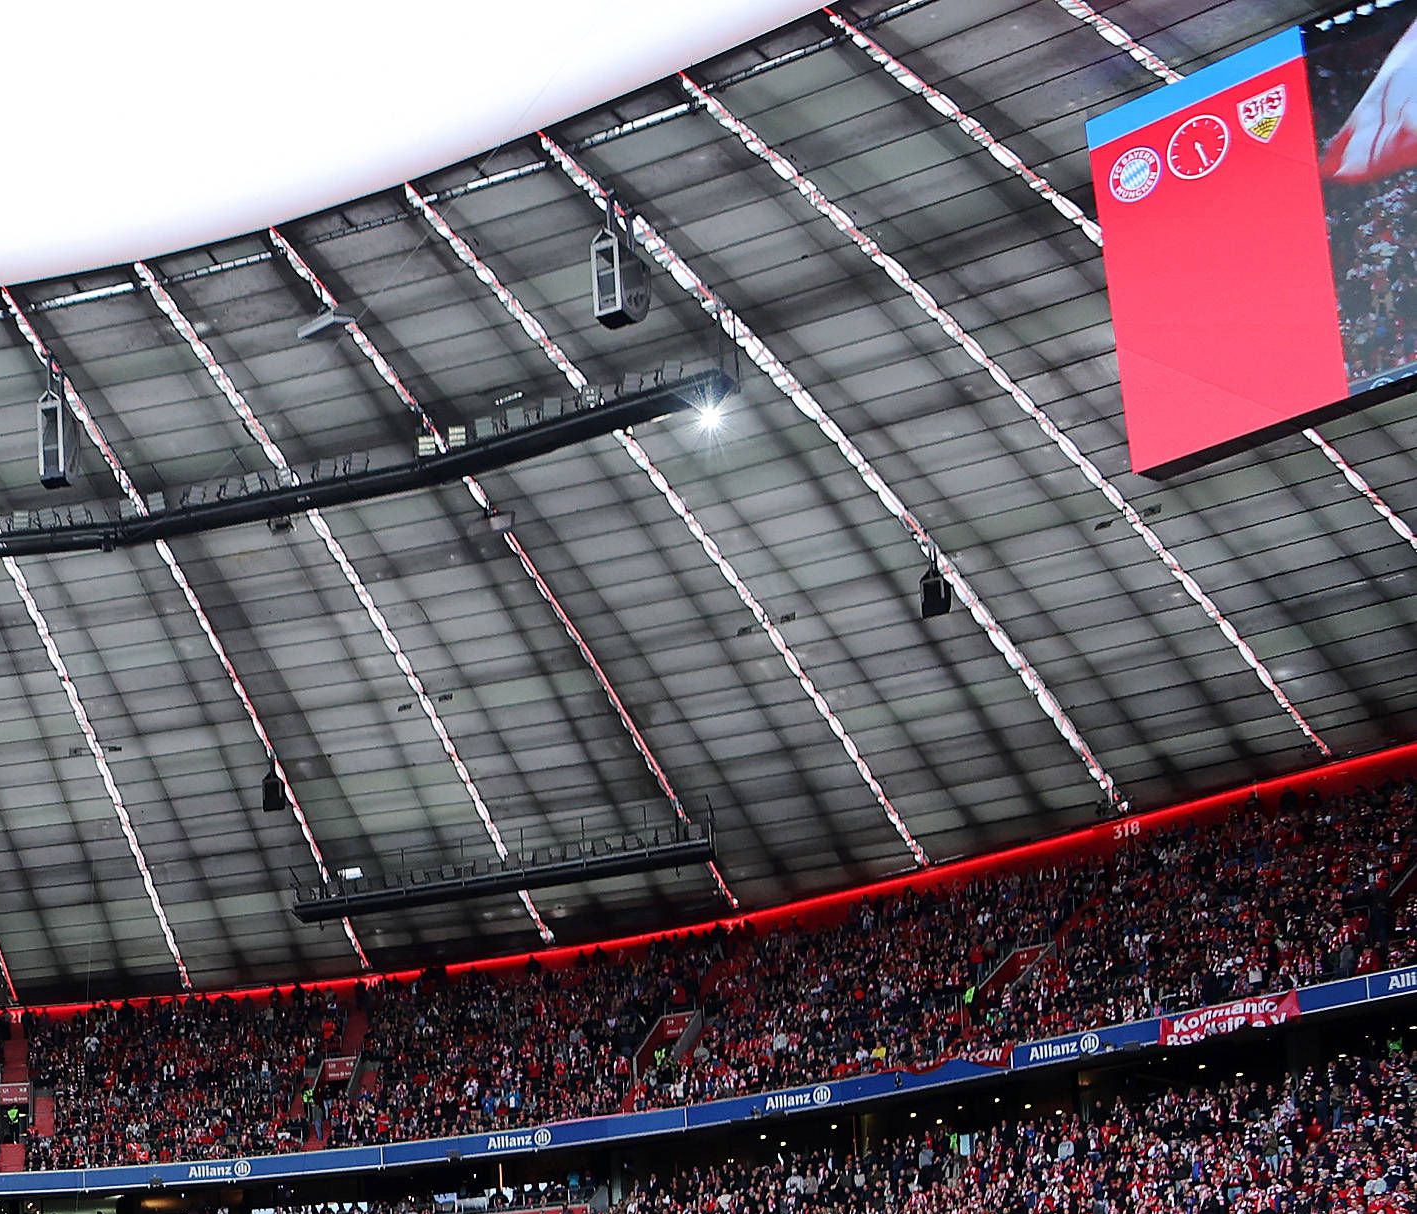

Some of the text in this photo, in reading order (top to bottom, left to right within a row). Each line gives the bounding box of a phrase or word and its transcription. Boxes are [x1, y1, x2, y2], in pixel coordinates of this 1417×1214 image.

[1120, 151, 1156, 167] BAYERN
[1115, 170, 1158, 199] MÜNCHEN
[1114, 821, 1140, 840] 318
[1029, 1043, 1077, 1061] Allianz
[766, 1092, 811, 1110] Allianz
[487, 1134, 532, 1149] Allianz
[189, 1165, 232, 1179] Allianz
